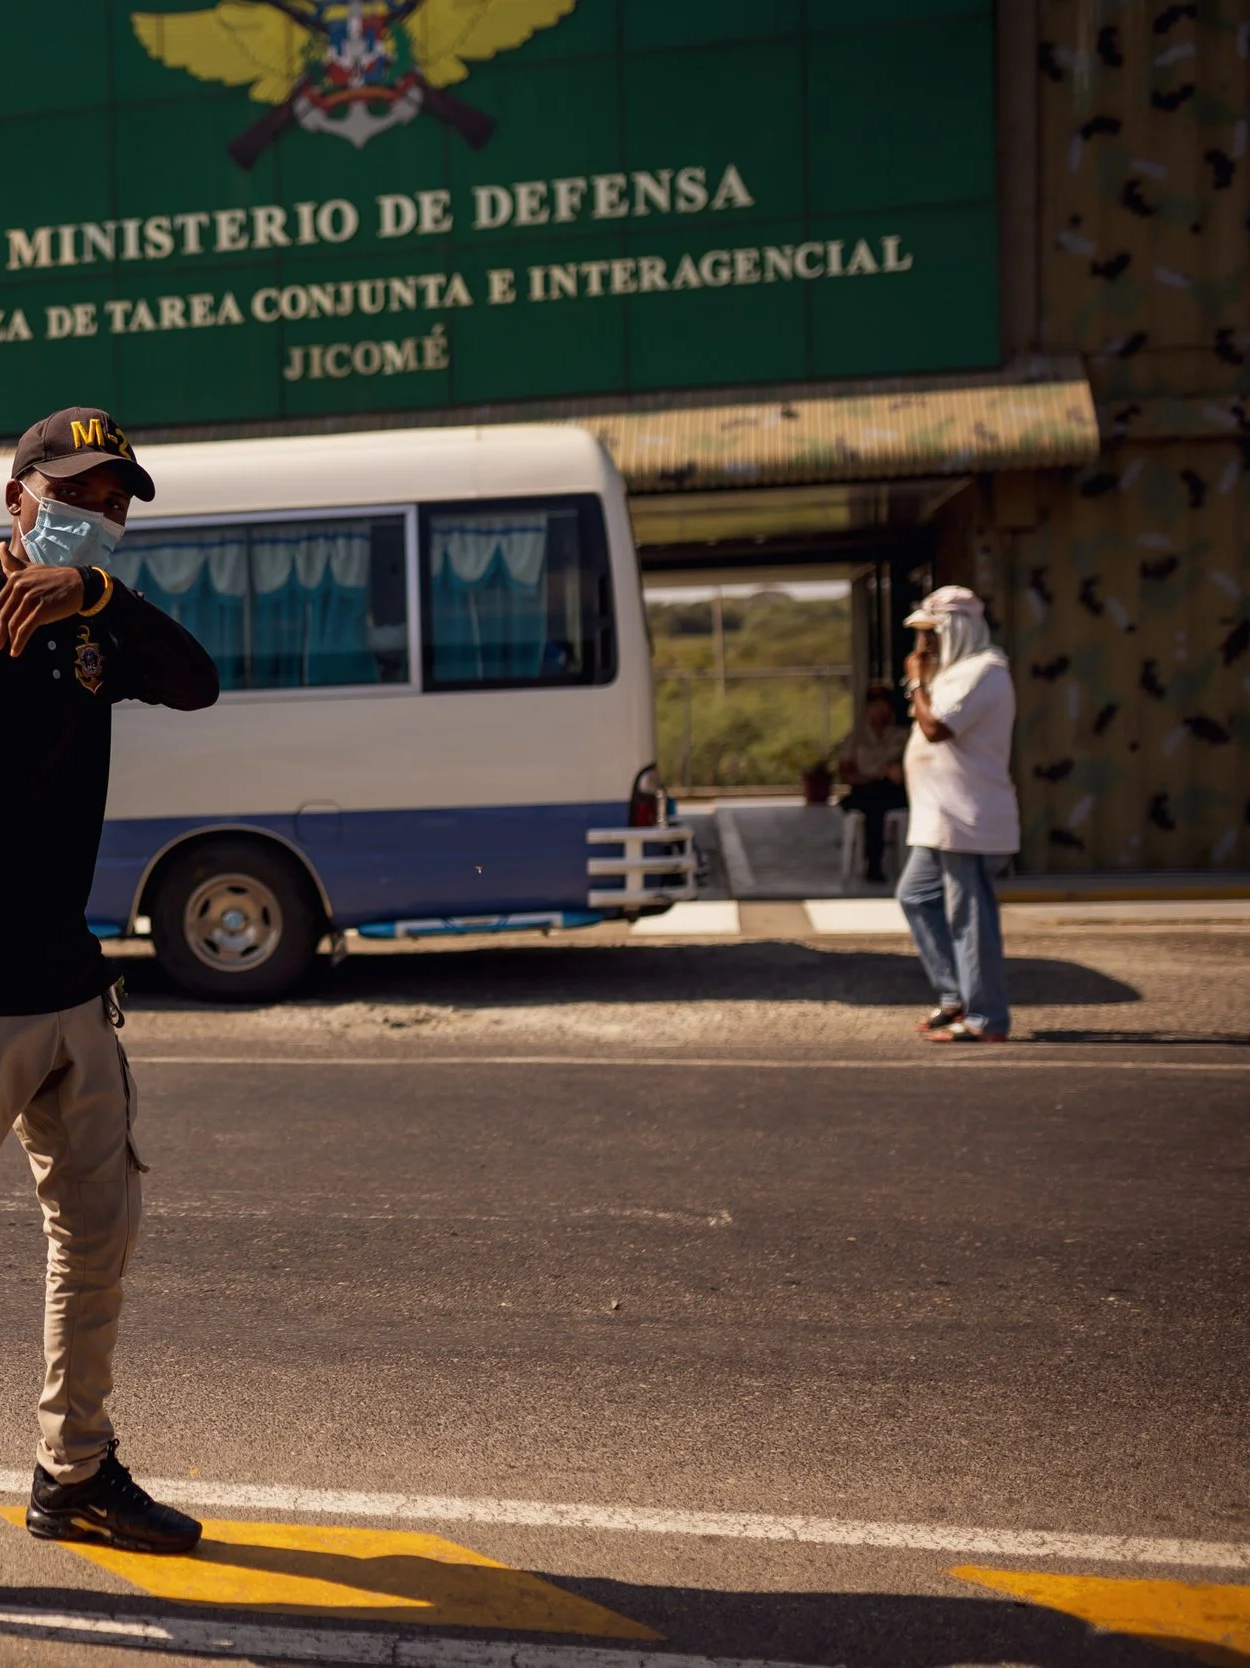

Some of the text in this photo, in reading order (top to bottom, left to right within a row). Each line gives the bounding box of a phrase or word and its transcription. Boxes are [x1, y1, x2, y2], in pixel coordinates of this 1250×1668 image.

[7, 166, 753, 270] MINISTERIO DE DEFENSA
[46, 303, 97, 339] DE
[105, 293, 243, 334] TAREA
[251, 273, 472, 322] CONJUNTA
[488, 269, 516, 305] E
[530, 236, 912, 301] INTERAGENCIAL
[284, 326, 449, 381] JICOMÉ
